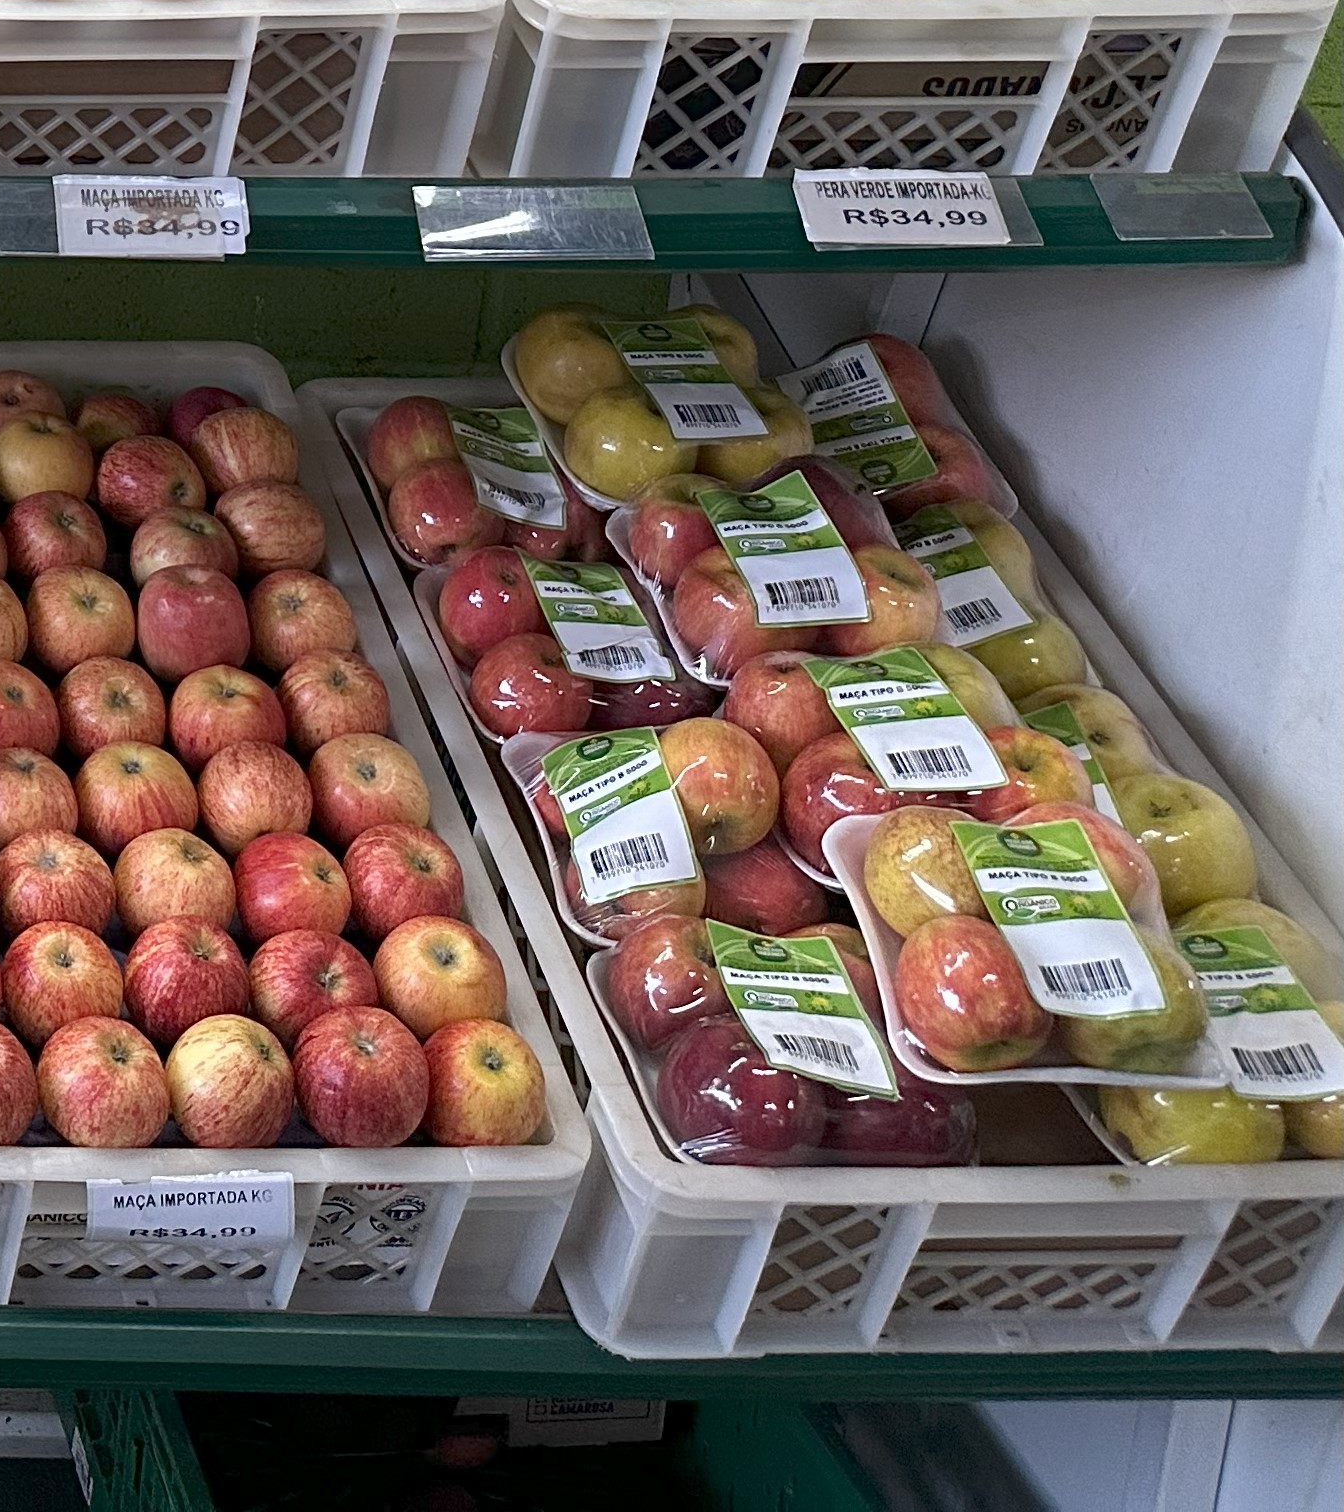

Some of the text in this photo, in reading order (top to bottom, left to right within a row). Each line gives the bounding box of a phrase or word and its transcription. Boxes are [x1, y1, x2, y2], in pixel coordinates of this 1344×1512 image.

[815, 182, 849, 199] PERA
[851, 182, 894, 199] VERDE
[81, 188, 225, 212] MAÇA IMPORTADA KG
[843, 208, 988, 228] R$34,99
[86, 217, 240, 239] R$34,99
[839, 687, 894, 700] MAÇA TIPO
[569, 787, 594, 803] MAÇA
[595, 776, 616, 790] TIPO
[988, 872, 1021, 881] MAÇA
[1024, 872, 1048, 880] TIPO
[731, 972, 762, 980] MAÇA
[114, 1189, 273, 1210] MAÇA IMPORTADA KG
[129, 1226, 256, 1239] R$34,99
